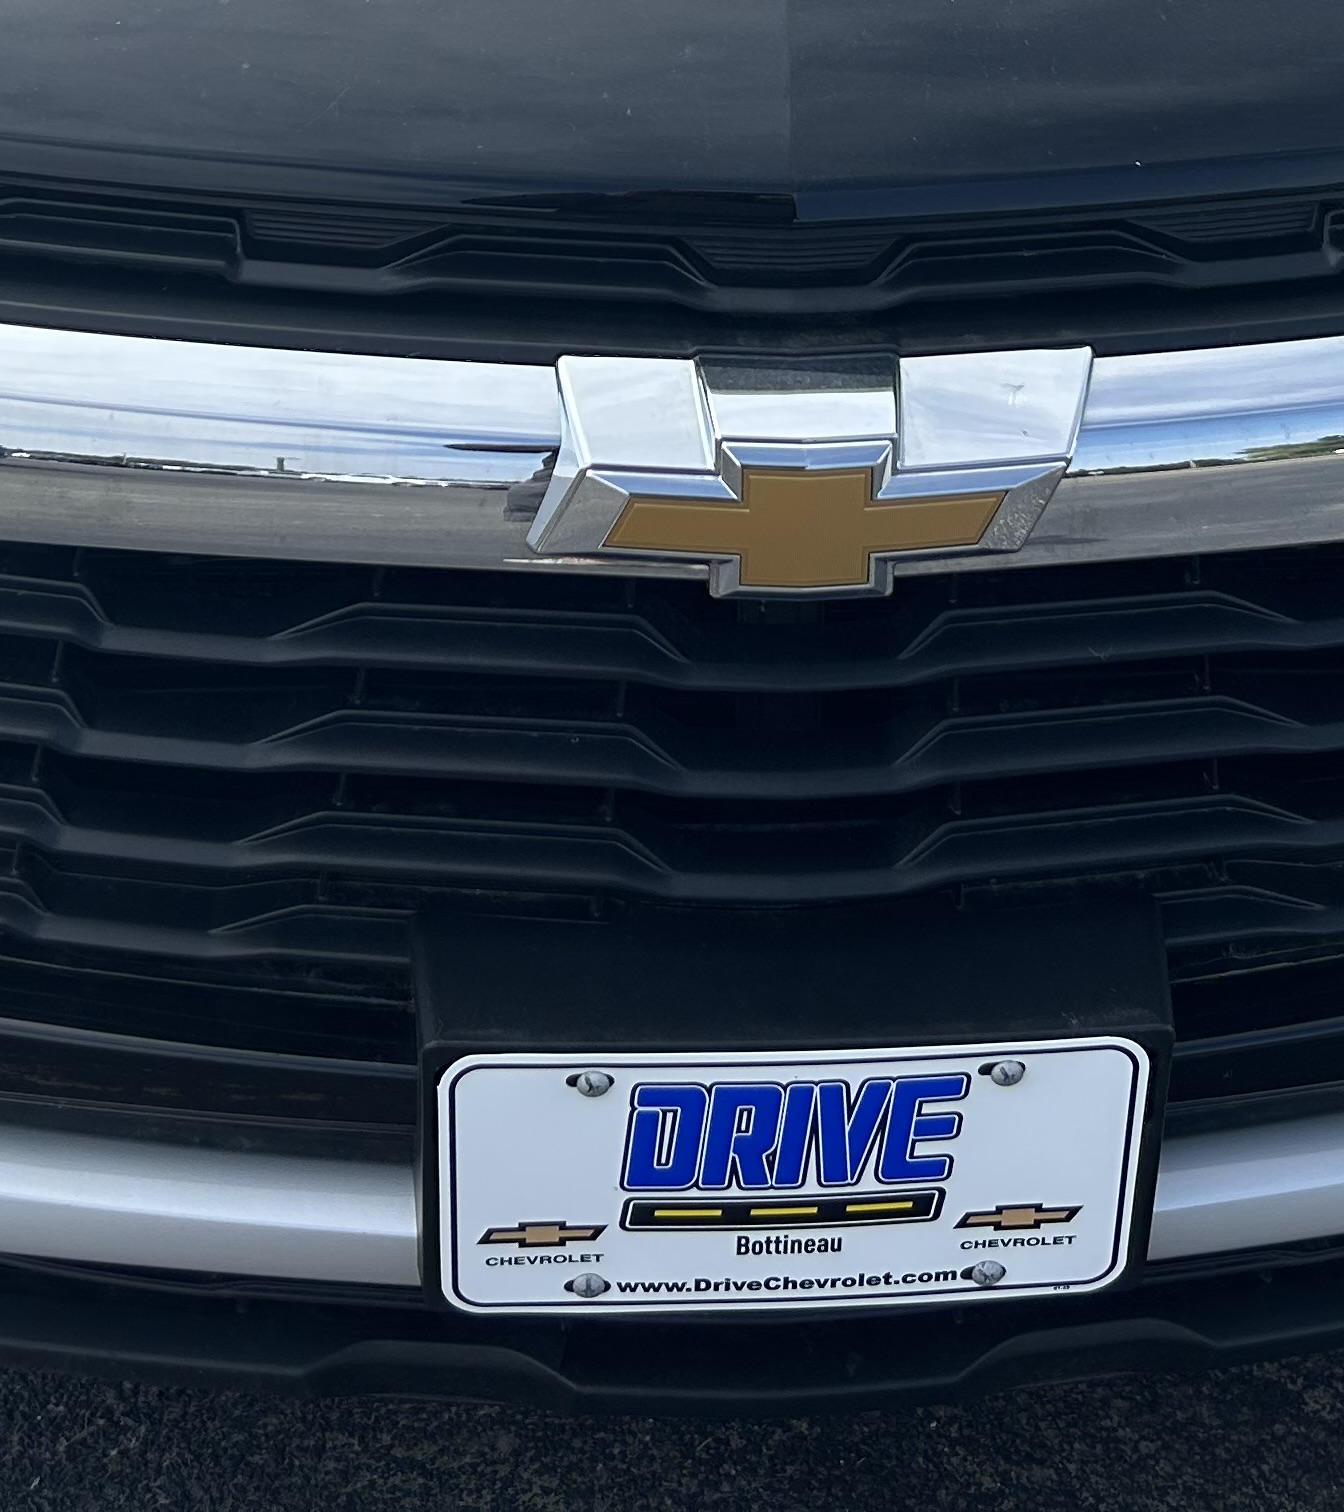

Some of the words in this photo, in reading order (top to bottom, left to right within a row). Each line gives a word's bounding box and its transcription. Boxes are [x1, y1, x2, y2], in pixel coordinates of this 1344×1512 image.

[618, 1071, 972, 1192] DRIVE
[735, 1233, 844, 1257] Bottineau
[959, 1234, 1078, 1252] CHEVROLET
[484, 1252, 605, 1267] CHEVROLET
[616, 1265, 959, 1294] www.DriveChevrolet.com
